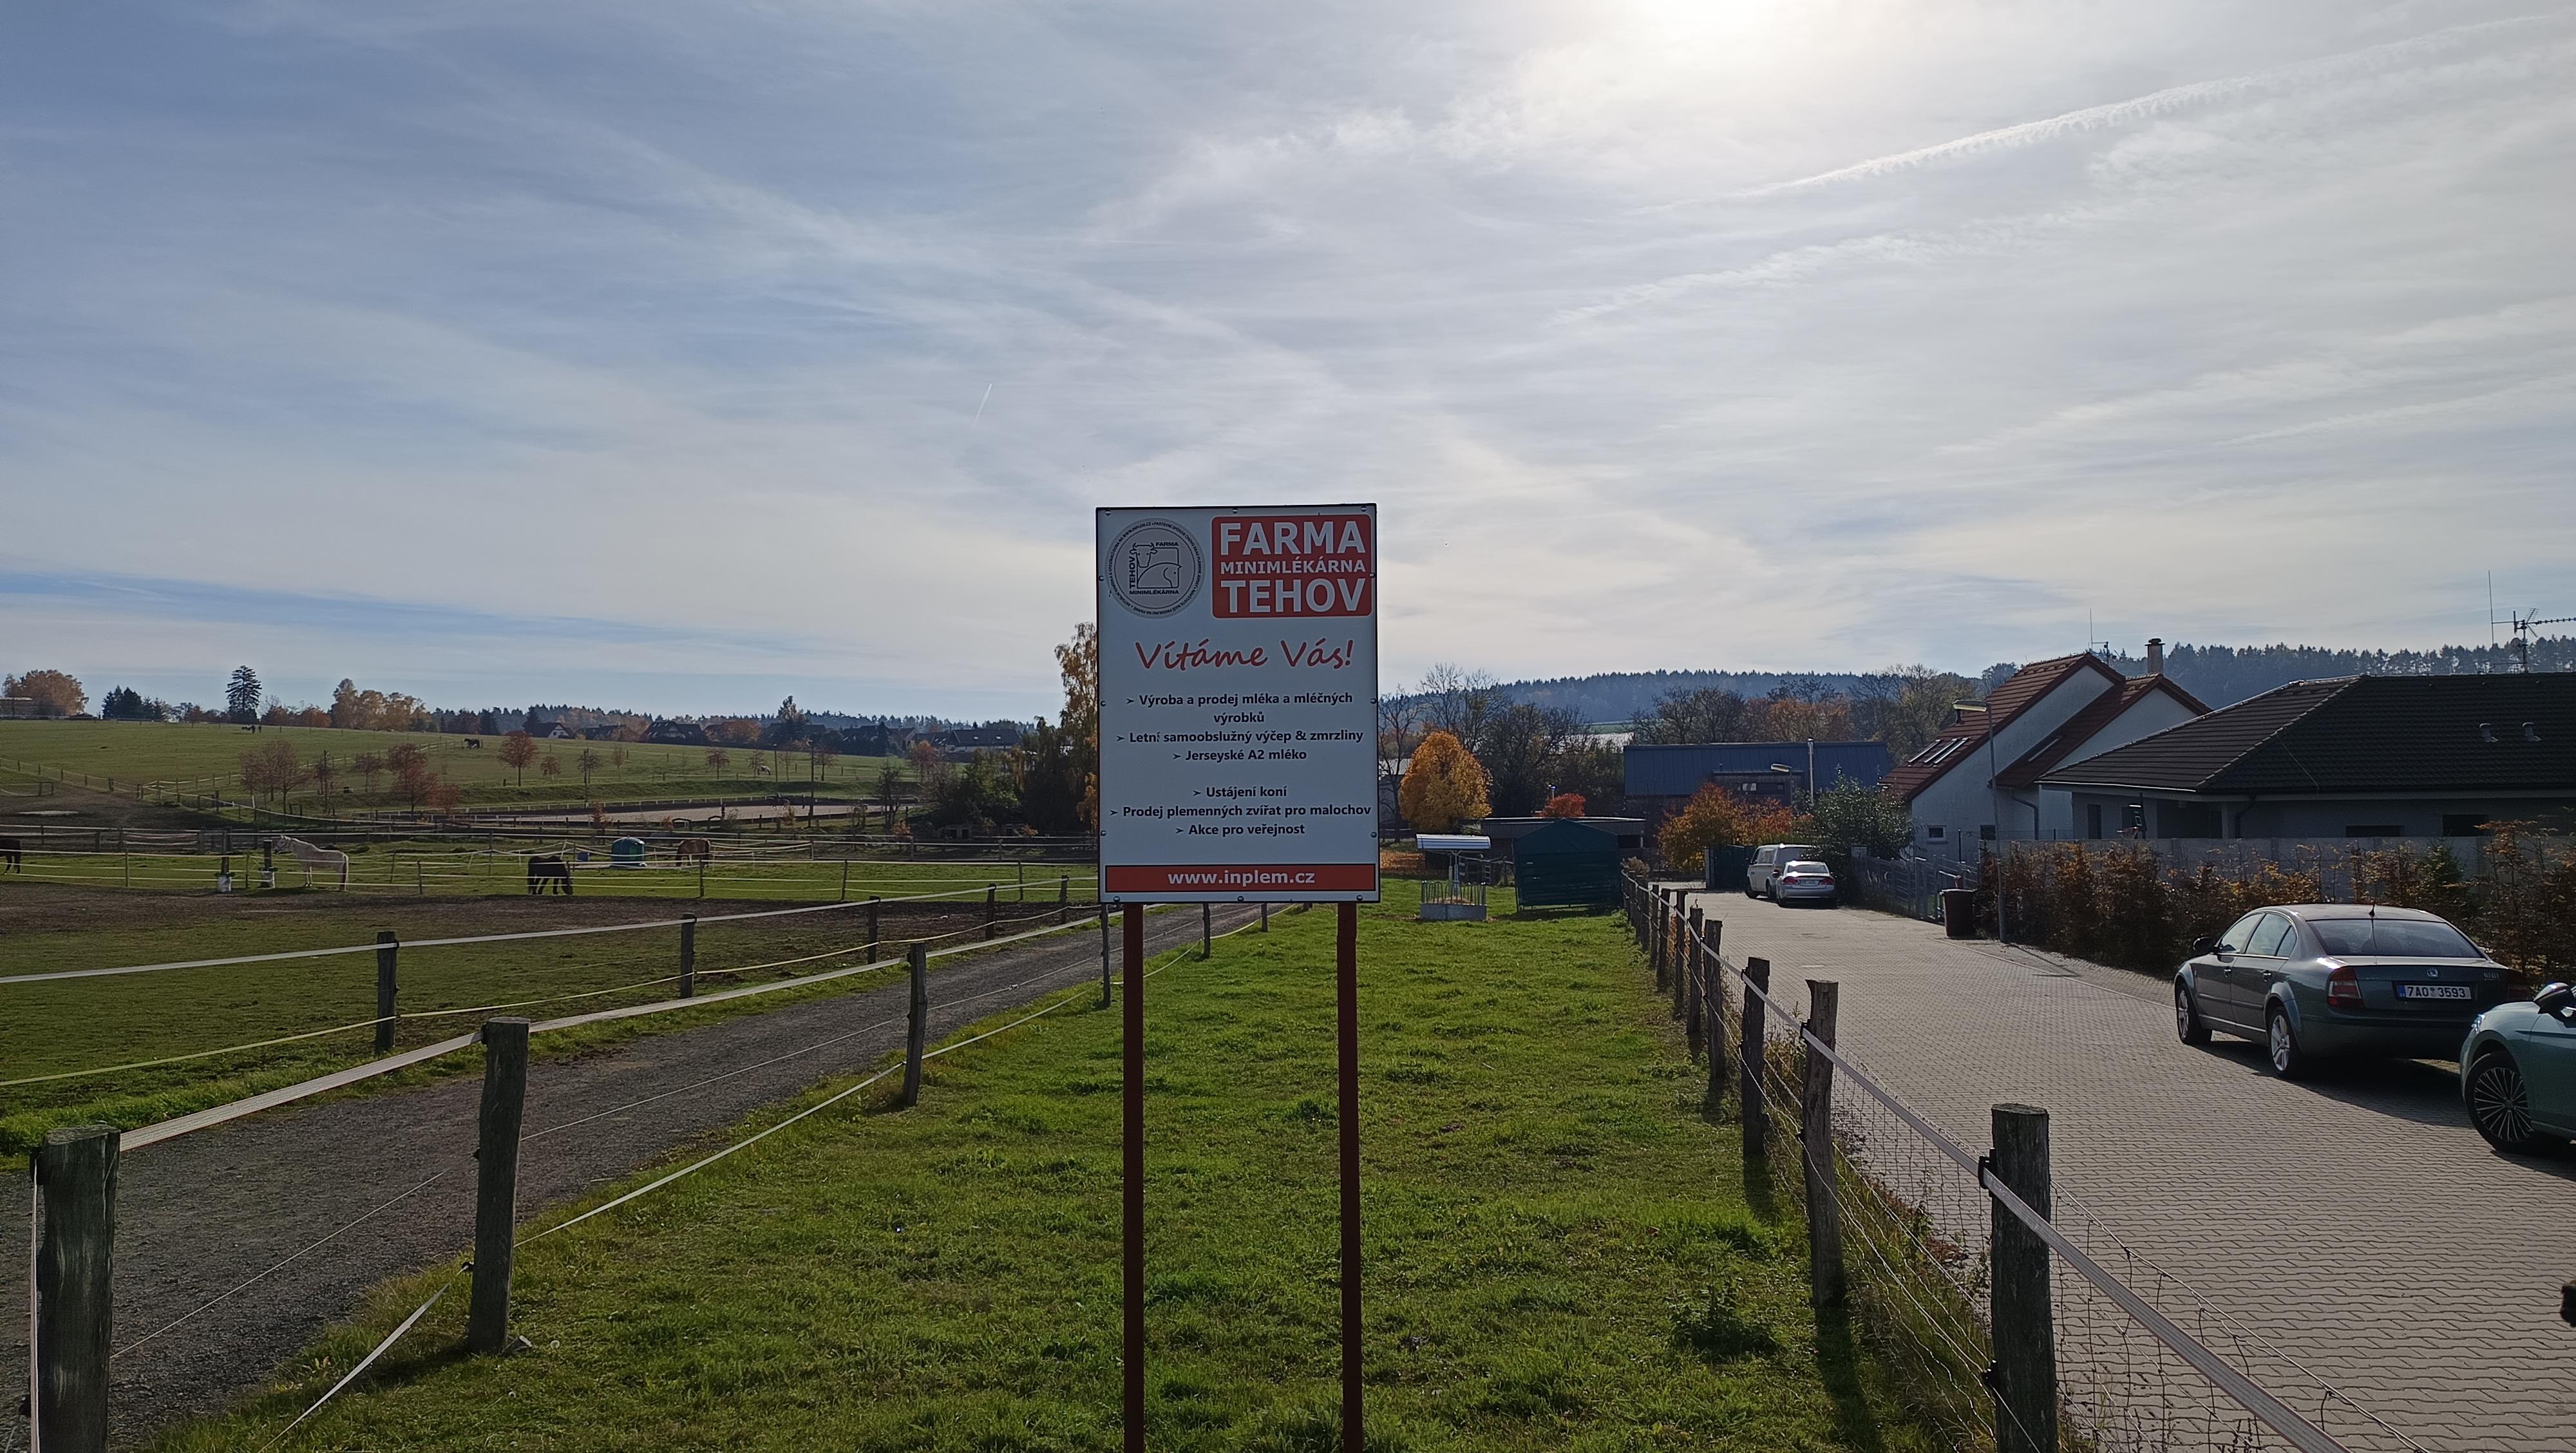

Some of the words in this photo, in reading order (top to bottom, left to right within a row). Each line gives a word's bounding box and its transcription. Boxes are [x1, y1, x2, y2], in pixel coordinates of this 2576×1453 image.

[1220, 520, 1366, 556] FARMA
[1220, 556, 1366, 575] MINIMLÉKÁRNA
[1220, 578, 1366, 613] TEHOV
[1135, 638, 1268, 671] Vítáme
[1280, 638, 1355, 670] Vás!
[1139, 694, 1184, 708] Výroba
[1198, 693, 1238, 707] prodej
[1242, 692, 1280, 704] mléka
[1294, 692, 1352, 706] mléčných
[1213, 710, 1264, 726] výrobků
[1130, 731, 1160, 743] Letní
[1163, 730, 1253, 745] samoobslužný
[1255, 730, 1292, 744] výčep
[1295, 730, 1307, 741] &
[1309, 729, 1364, 743] zmrzliny
[1185, 749, 1245, 763] Jerseyské
[1247, 749, 1265, 760] A2
[1269, 748, 1307, 760] mléko
[1206, 786, 1256, 800] Ustájení
[1260, 786, 1287, 797] koní
[1123, 806, 1163, 819] Prodej
[1167, 804, 1242, 819] plemenných
[1245, 804, 1282, 815] zvířat
[1285, 807, 1306, 819] pro
[1310, 804, 1371, 815] malochov
[1188, 824, 1219, 835] Akce
[1222, 826, 1244, 837] pro
[1247, 823, 1305, 837] veřejnost
[1168, 869, 1315, 887] www.inplem.cz
[2407, 986, 2429, 997] 7A0
[2438, 987, 2466, 998] 3593
